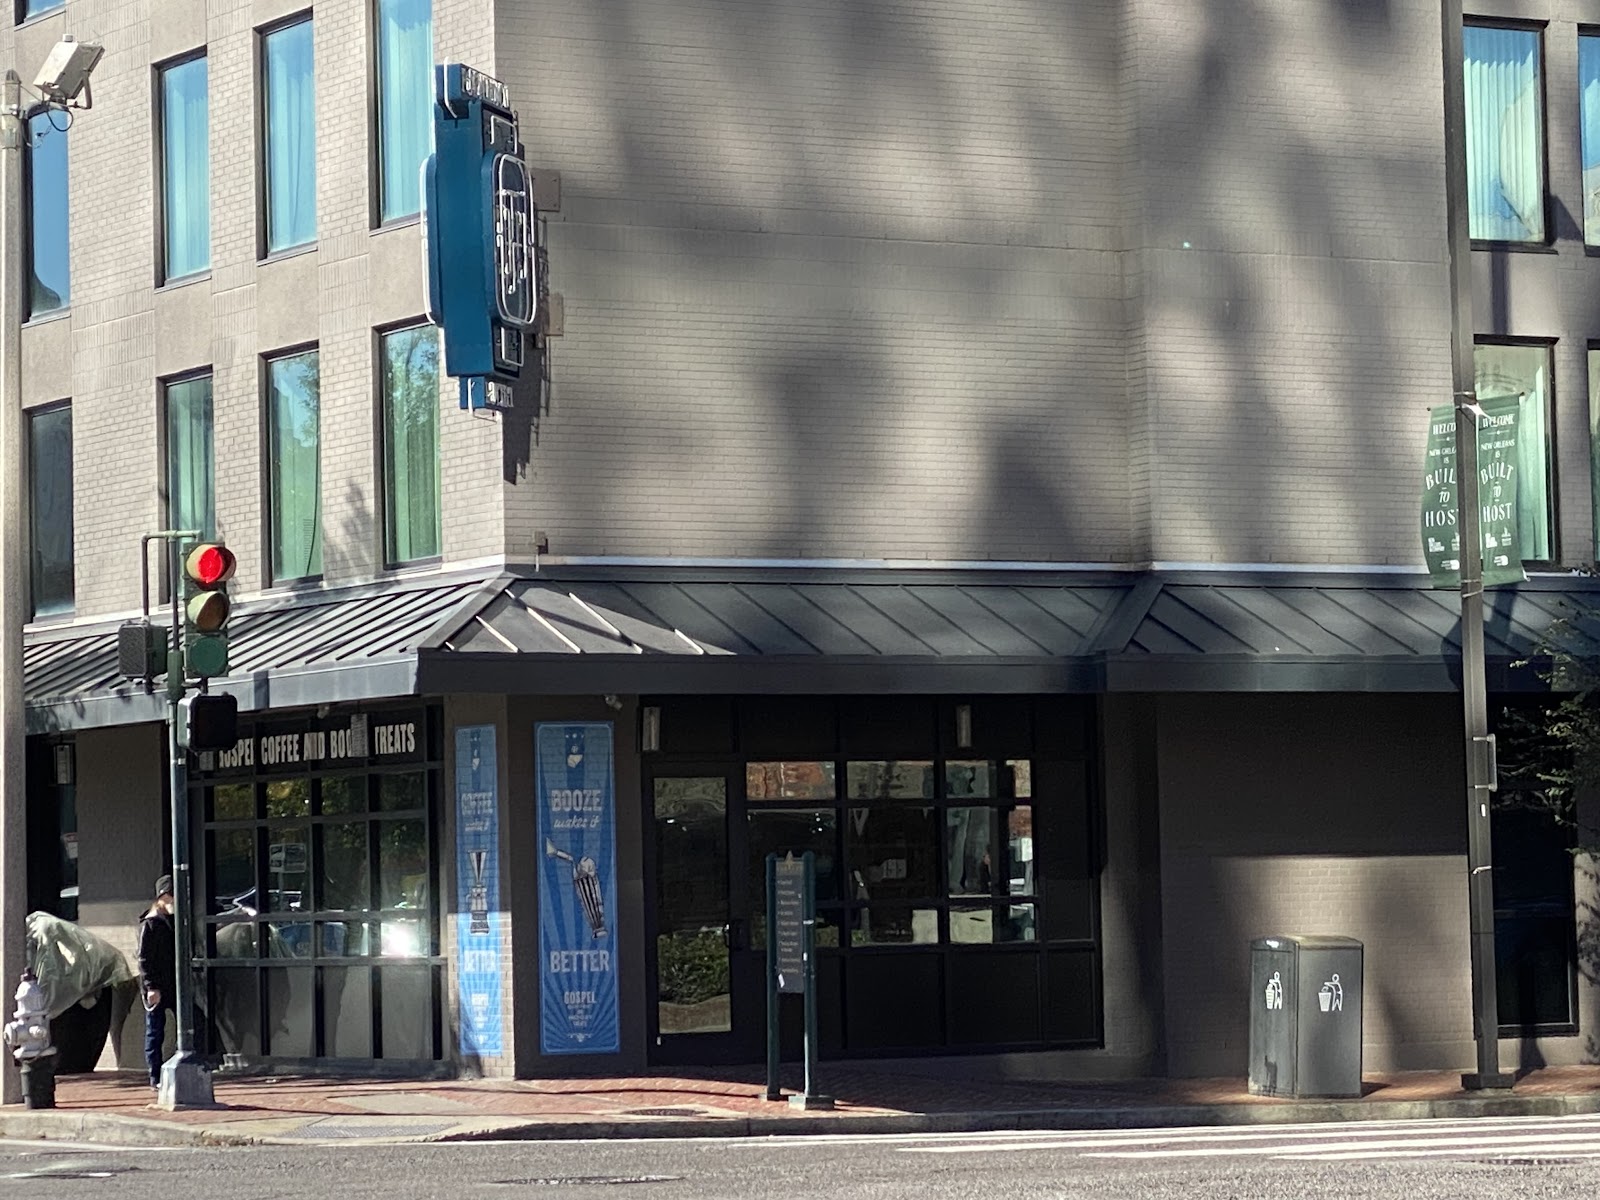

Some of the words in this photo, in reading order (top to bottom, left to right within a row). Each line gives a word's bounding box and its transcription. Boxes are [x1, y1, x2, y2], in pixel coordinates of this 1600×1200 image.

[1432, 422, 1456, 435] WELCO
[1482, 414, 1515, 428] WELCOME
[1429, 448, 1441, 457] NEW
[1481, 442, 1493, 451] NEW
[1494, 439, 1515, 449] ORLEANS
[1425, 468, 1456, 490] BUIL
[1480, 462, 1514, 485] BUILT
[1438, 491, 1450, 503] TO
[1493, 485, 1502, 498] TO
[1425, 508, 1459, 528] HOS
[1482, 502, 1512, 523] HOST
[261, 734, 299, 765] COFFEE
[303, 732, 325, 761] AND
[330, 728, 352, 759] BOO
[375, 723, 415, 755] TREATS
[551, 789, 602, 812] BOOZE
[550, 949, 610, 974] BETTER
[564, 991, 597, 1005] GOSPEL
